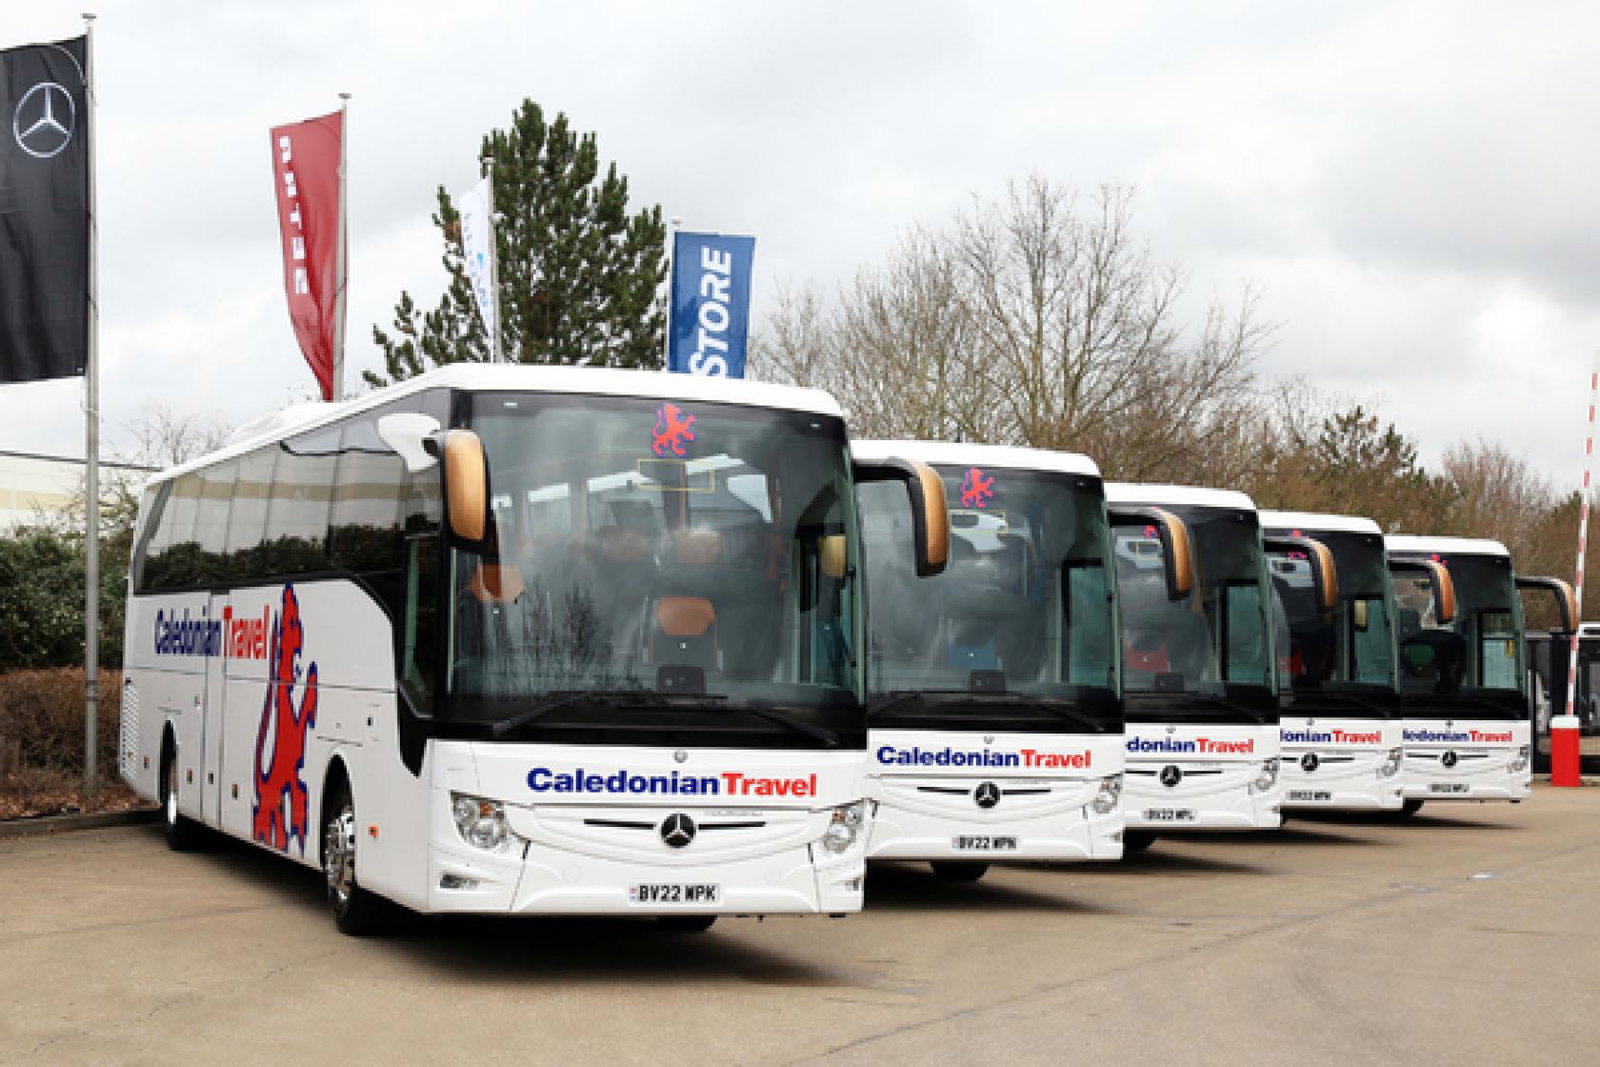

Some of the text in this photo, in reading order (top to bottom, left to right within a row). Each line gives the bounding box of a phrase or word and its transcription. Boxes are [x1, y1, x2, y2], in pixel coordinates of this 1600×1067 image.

[689, 246, 732, 377] STORE
[154, 605, 270, 660] Caledonian Travel
[1331, 728, 1382, 744] Travel
[1468, 729, 1513, 742] Travel
[1195, 737, 1254, 754] Travel
[876, 746, 1092, 768] Caledonian Travel
[526, 767, 817, 797] Caledonian Travel
[639, 885, 716, 902] BV22 WPK
